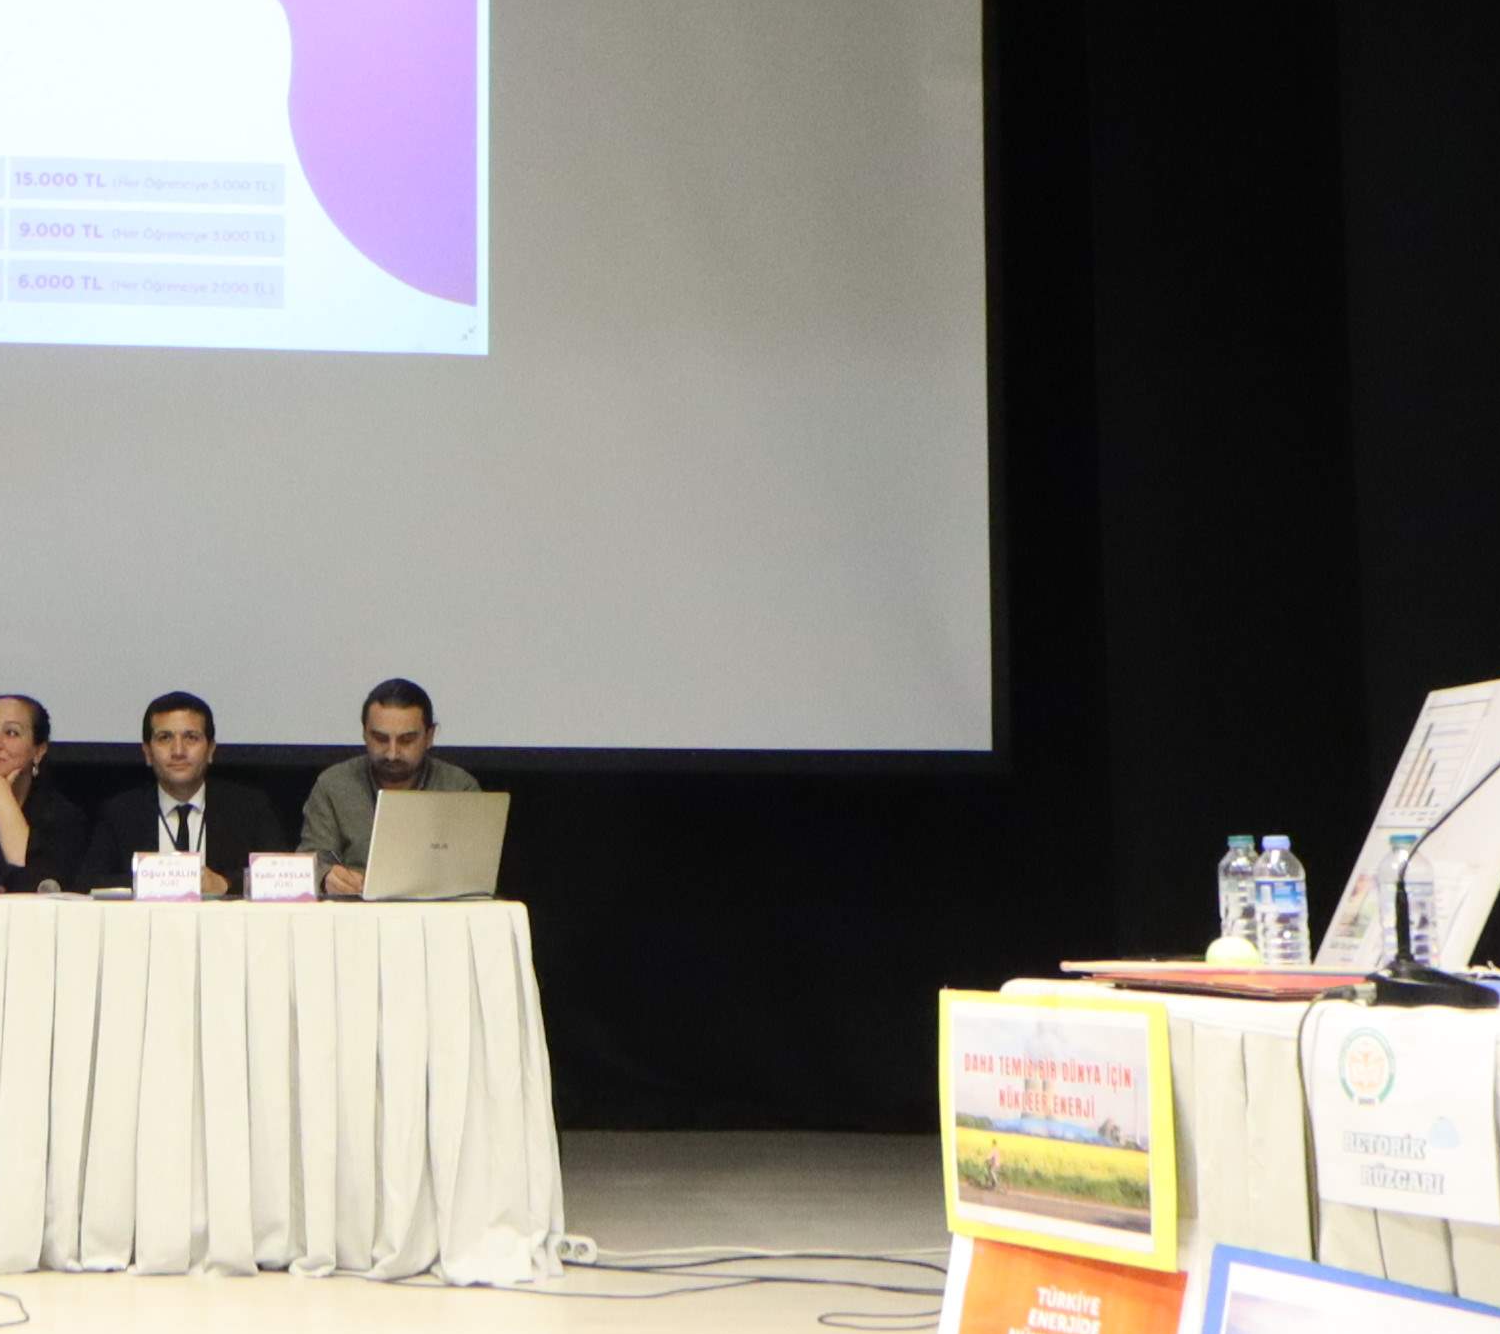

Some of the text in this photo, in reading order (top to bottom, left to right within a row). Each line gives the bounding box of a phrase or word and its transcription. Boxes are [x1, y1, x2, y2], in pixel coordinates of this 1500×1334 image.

[14, 171, 78, 188] 15.000
[84, 172, 106, 189] TL
[18, 222, 76, 239] 9.000
[82, 223, 105, 240] TL
[17, 274, 76, 291] 6.000
[81, 275, 104, 292] TL
[963, 1052, 994, 1074] DAHA
[1036, 1057, 1058, 1080] BİR
[1061, 1058, 1102, 1087] DÜNYA
[1105, 1060, 1133, 1093] İÇİN
[998, 1084, 1096, 1118] NÜKLEER ENERJİ
[1036, 1284, 1102, 1316] TÜRKİYE
